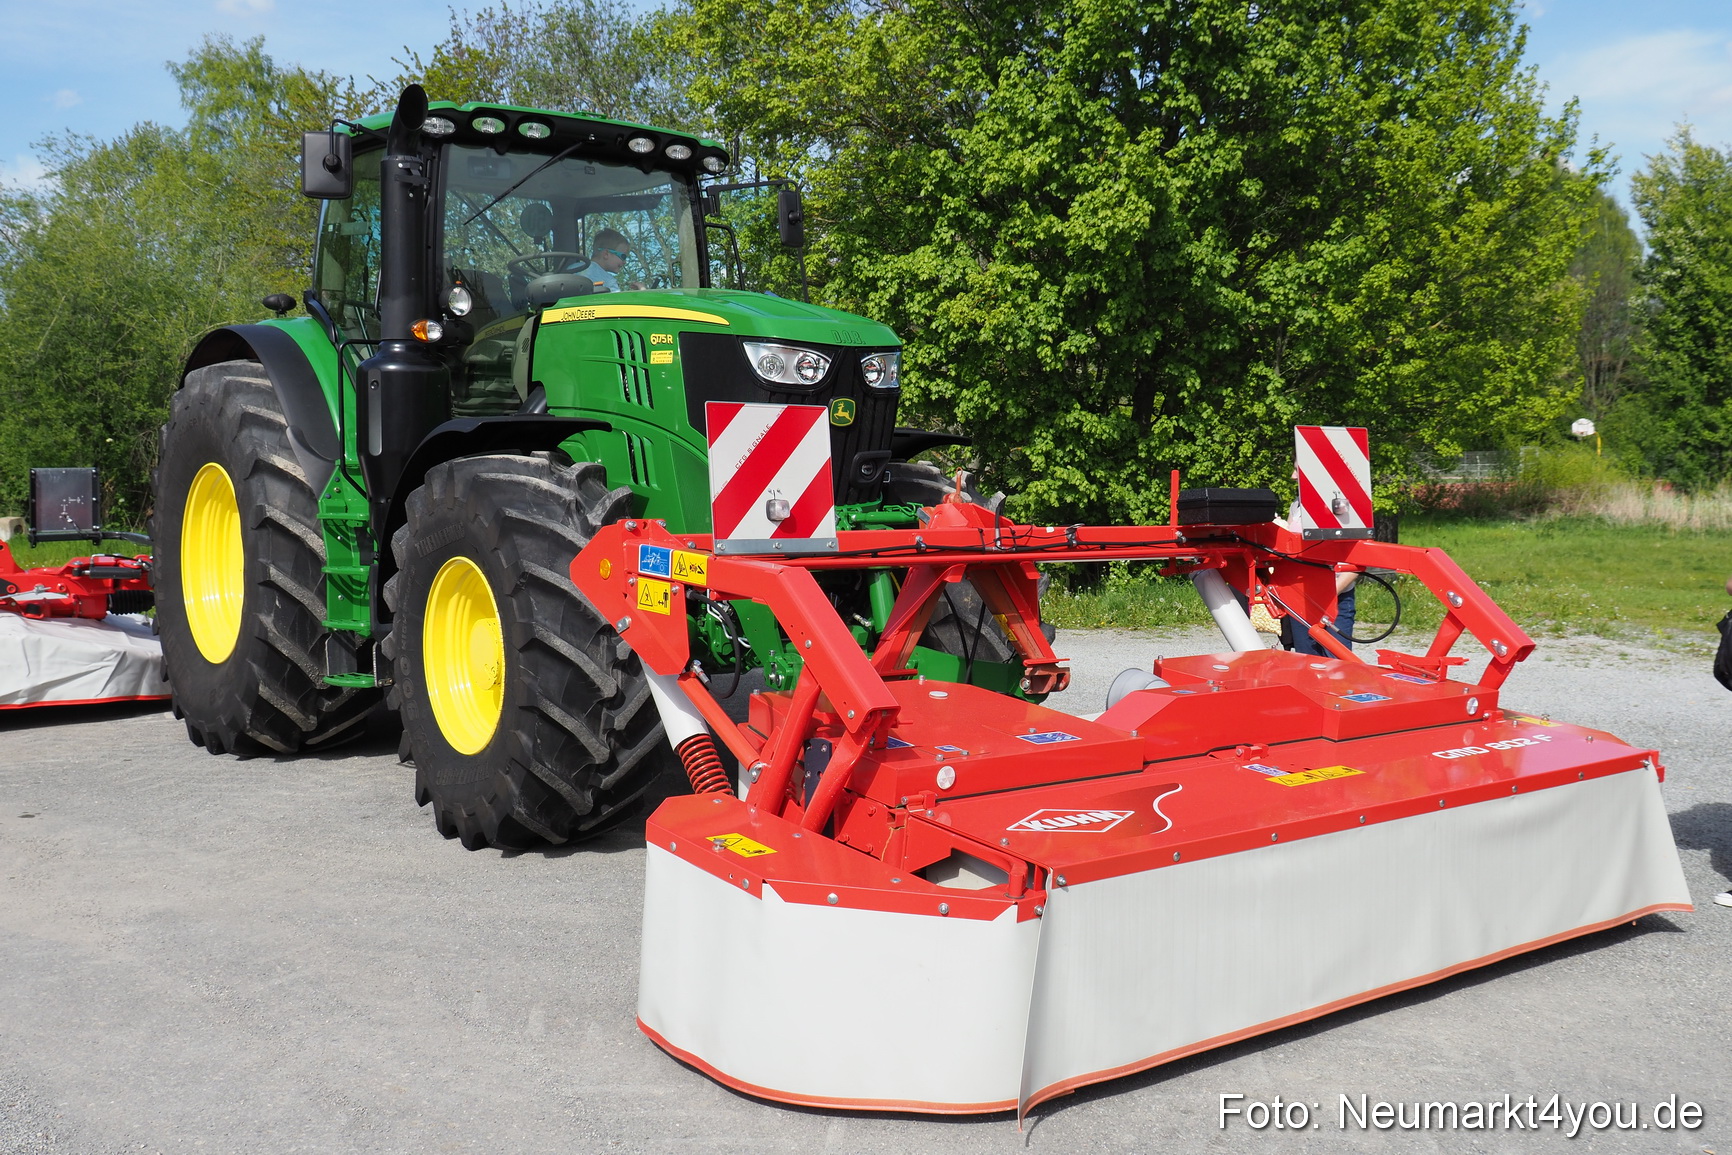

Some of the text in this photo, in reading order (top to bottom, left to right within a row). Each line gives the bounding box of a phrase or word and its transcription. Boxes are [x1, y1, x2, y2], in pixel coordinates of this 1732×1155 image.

[561, 308, 596, 322] JOHN DEERE
[1432, 734, 1552, 759] GMD 802 F
[1019, 810, 1125, 831] KUHN
